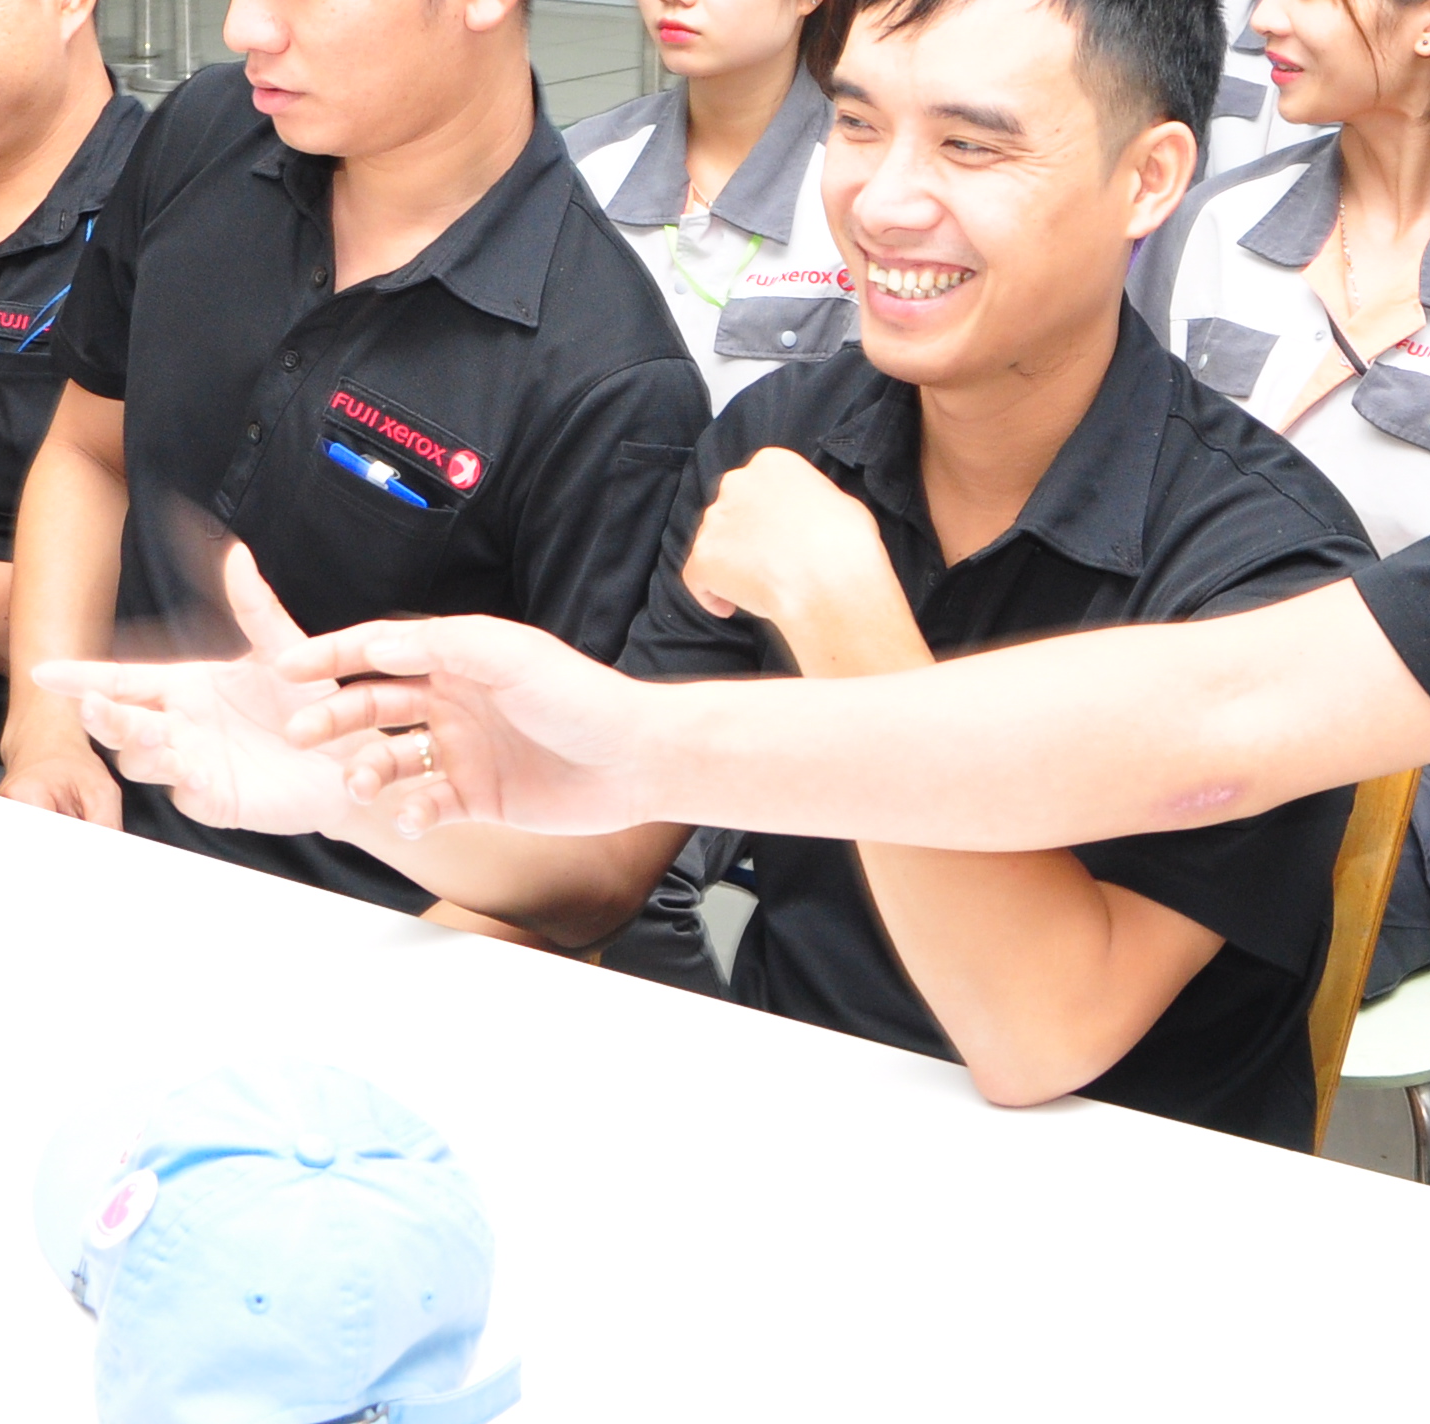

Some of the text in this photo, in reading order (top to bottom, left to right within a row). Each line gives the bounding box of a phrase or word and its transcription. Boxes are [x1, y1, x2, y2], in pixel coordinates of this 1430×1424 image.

[778, 270, 833, 285] xerox
[330, 391, 447, 467] FUJI xerox
